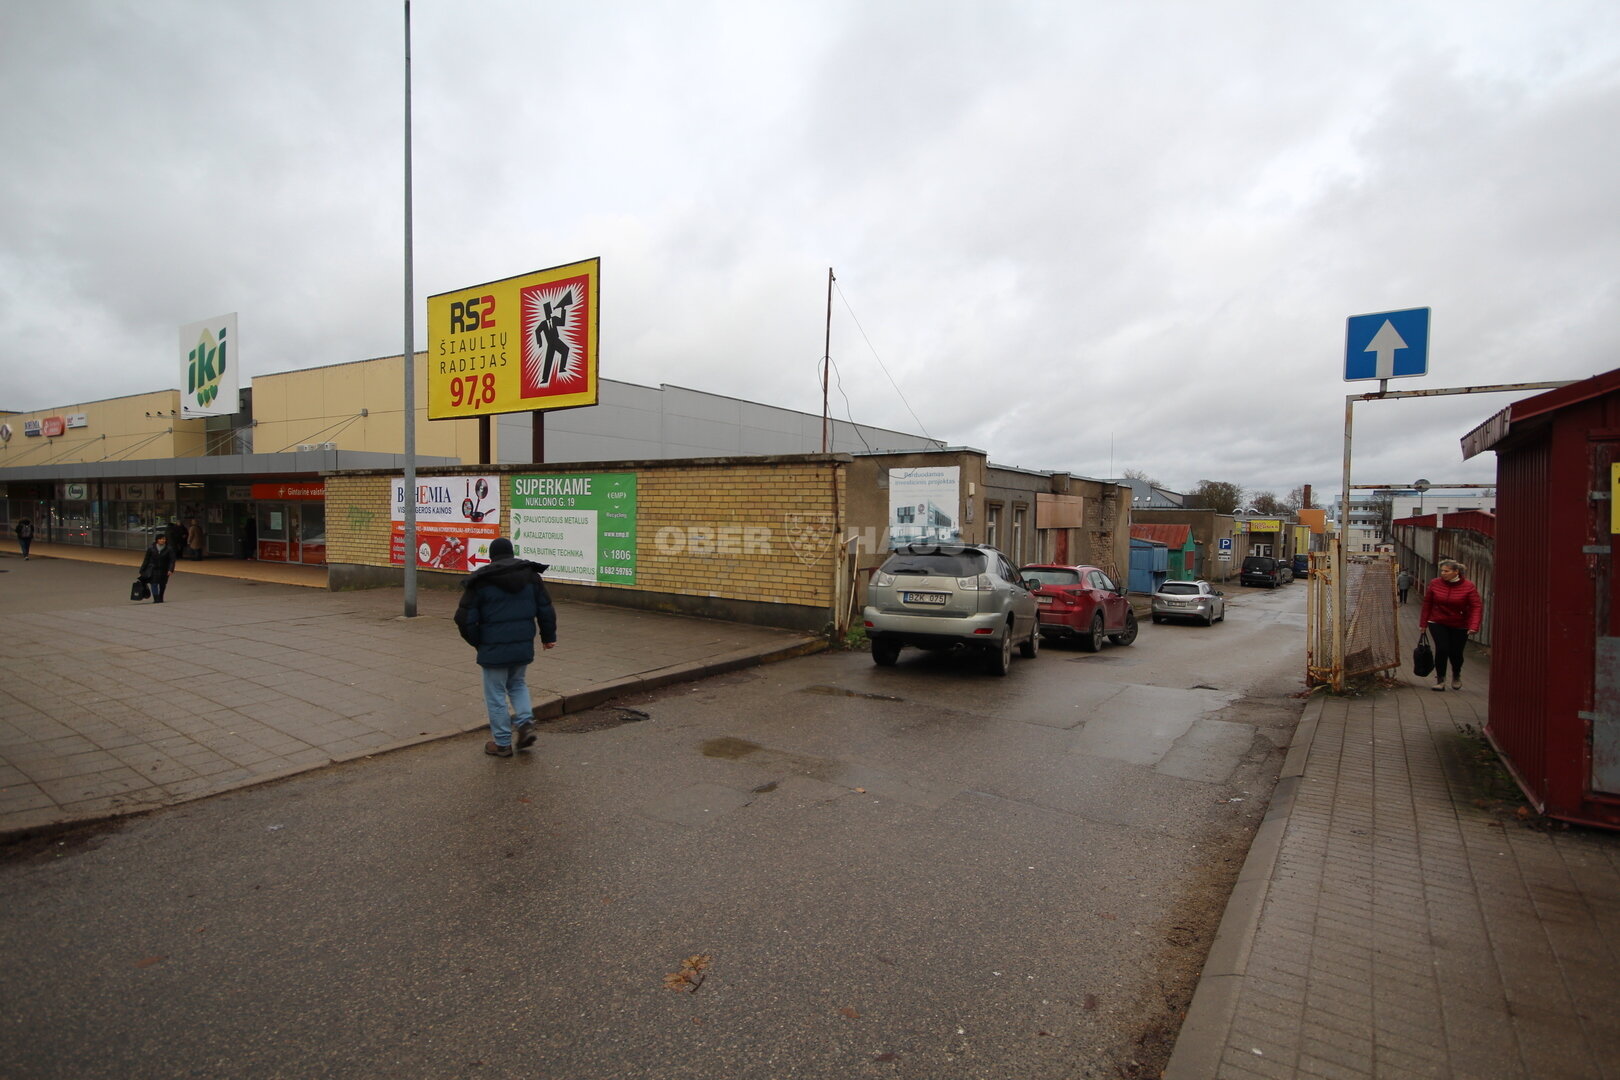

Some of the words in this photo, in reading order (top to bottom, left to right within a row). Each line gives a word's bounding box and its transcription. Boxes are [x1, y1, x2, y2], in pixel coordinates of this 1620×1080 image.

[451, 295, 496, 334] RS2
[440, 332, 507, 356] ŠIAULIŲ
[188, 327, 226, 395] iki
[440, 352, 507, 374] RADIJAS
[450, 373, 496, 409] 97,8
[397, 485, 452, 504] BHEMIA
[515, 478, 592, 495] SUPERKAME
[432, 506, 452, 515] KAINOS
[525, 497, 557, 506] NUKLONO
[558, 498, 566, 506] G.
[567, 498, 575, 507] 19
[524, 515, 563, 524] SPALVOTUOSIUS
[564, 516, 589, 525] METALUS
[523, 531, 564, 540] KATALIZATORIUS
[611, 549, 631, 560] 1806
[909, 593, 925, 601] BZK
